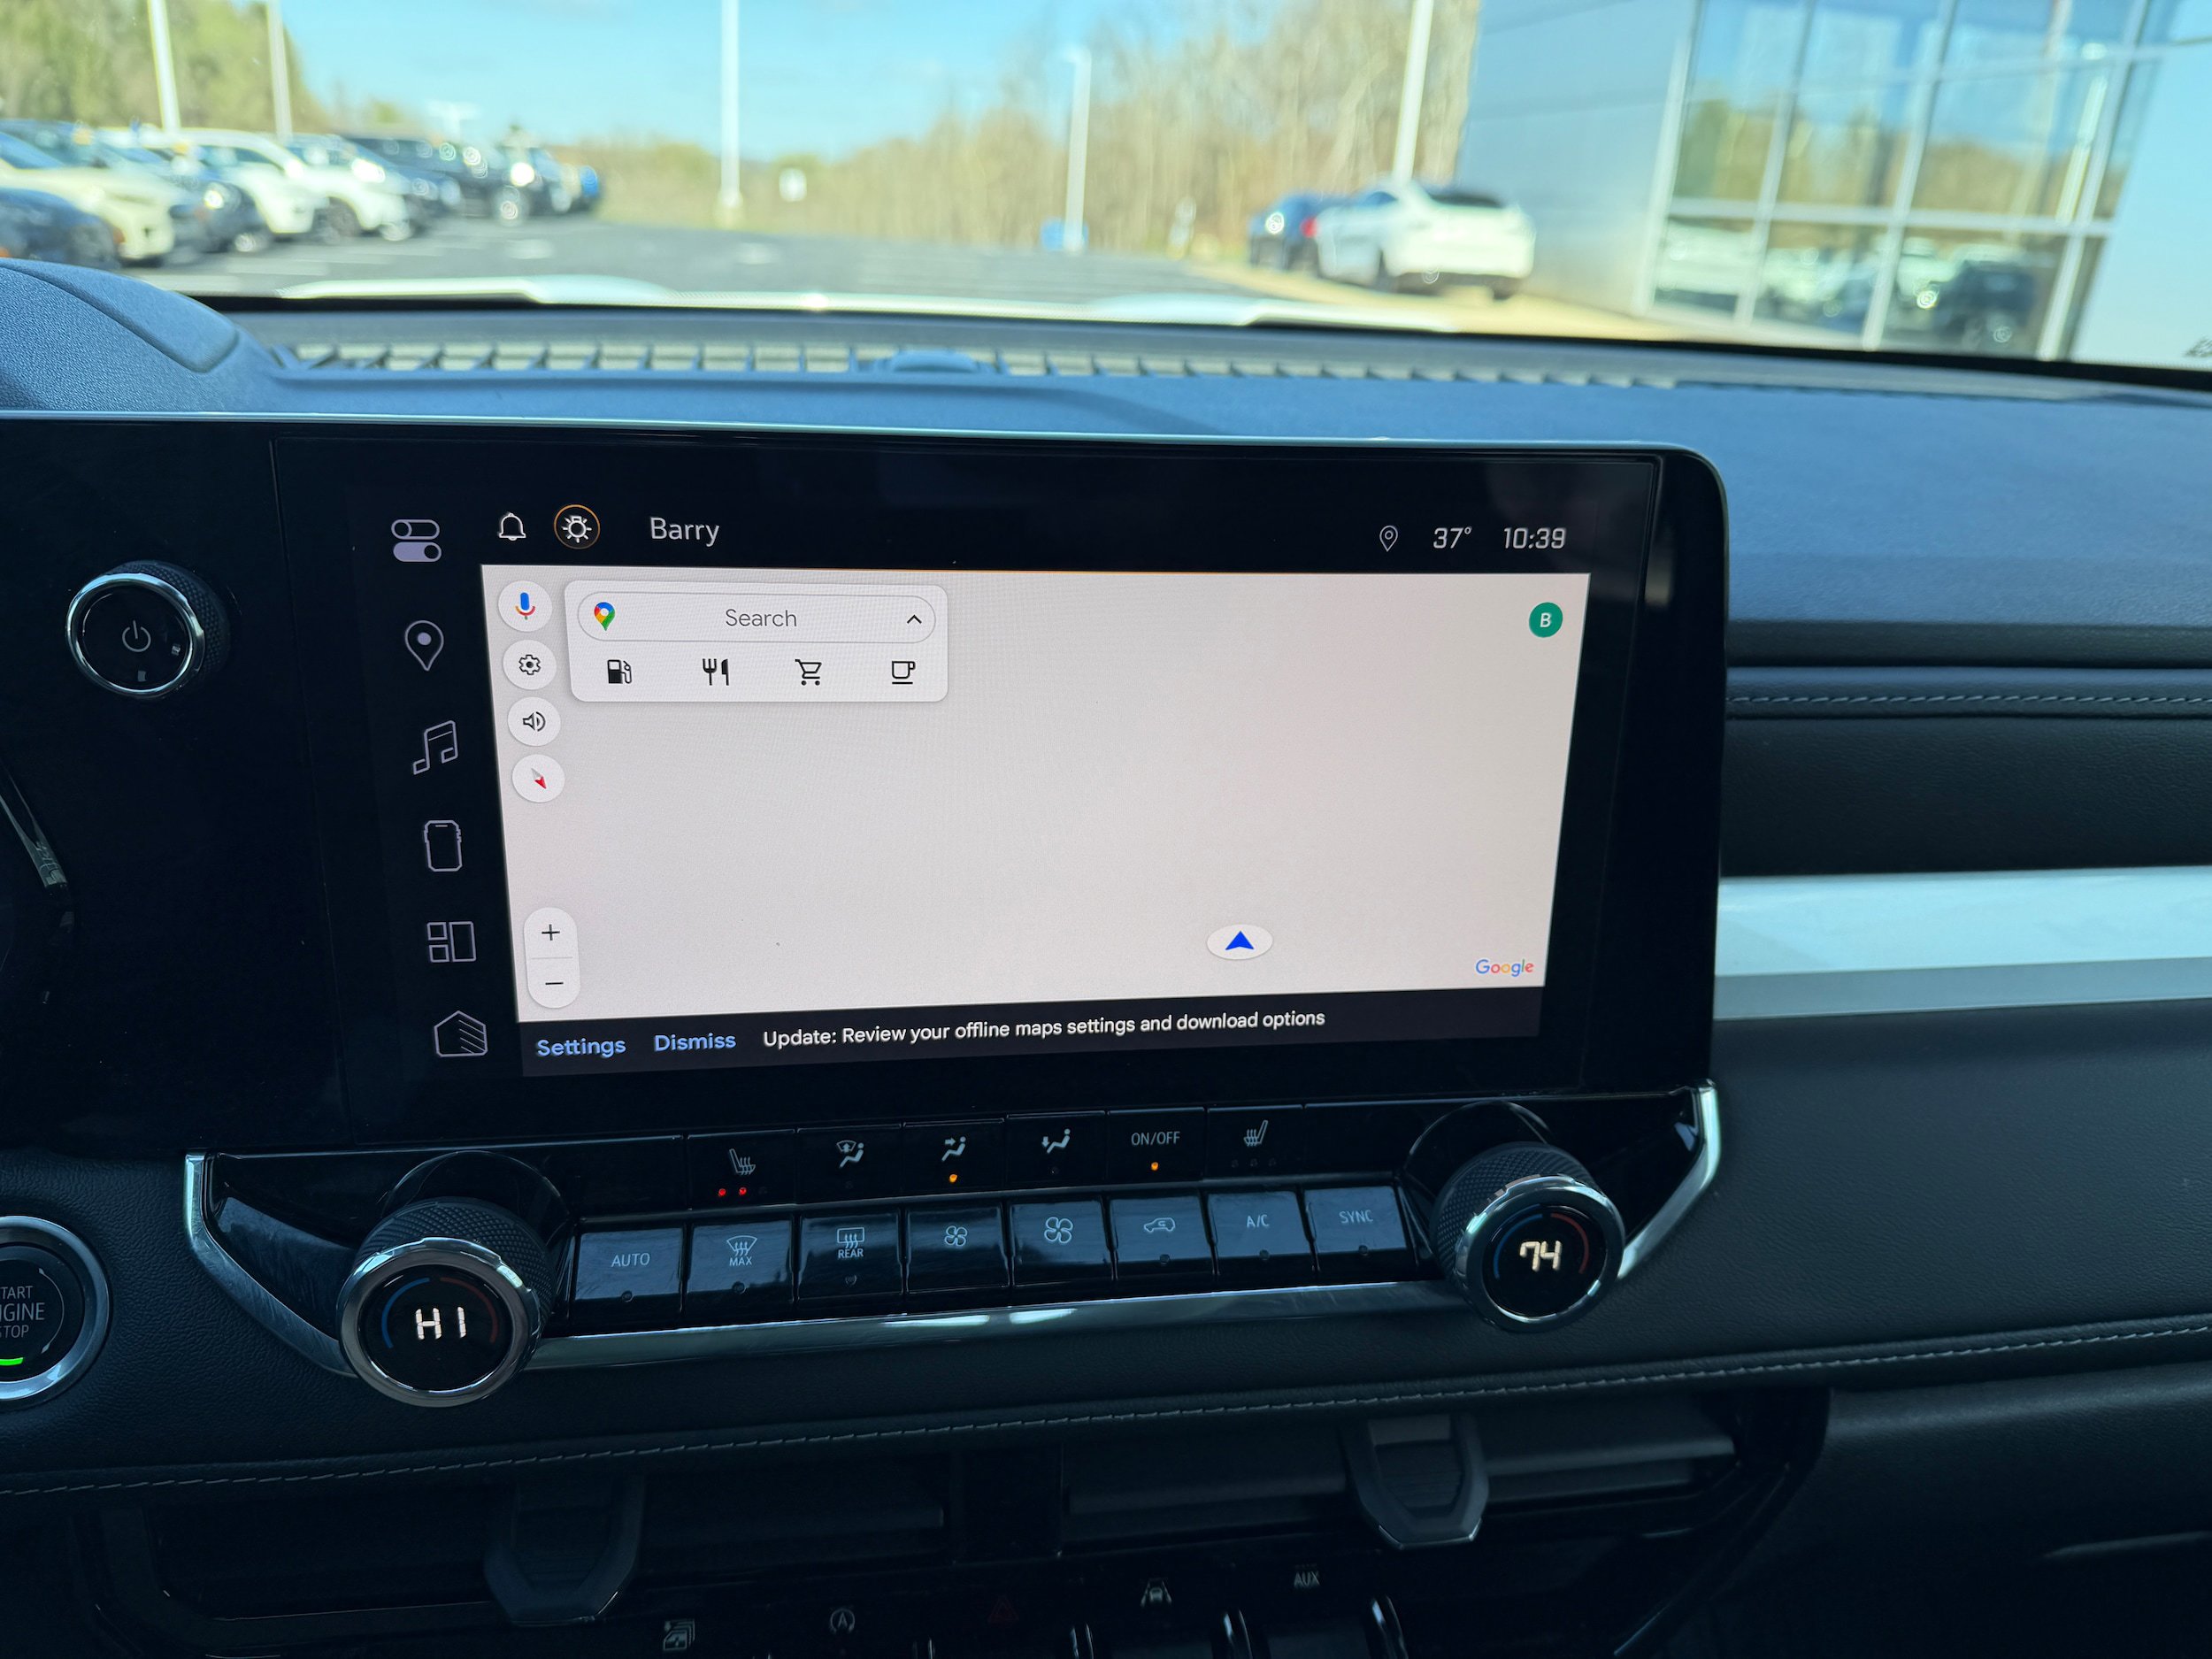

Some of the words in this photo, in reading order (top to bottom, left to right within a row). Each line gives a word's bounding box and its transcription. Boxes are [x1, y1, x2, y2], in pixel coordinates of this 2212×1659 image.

[649, 516, 720, 548] Barry
[1432, 526, 1473, 549] 37°
[1503, 526, 1567, 549] 10:39
[725, 608, 798, 627] Search
[1540, 611, 1552, 628] B
[1475, 956, 1535, 978] Google
[763, 1027, 838, 1048] Update:
[842, 1025, 907, 1044] Review
[910, 1024, 950, 1044] your
[954, 1020, 1010, 1040] offline
[1015, 1019, 1063, 1040] maps
[1066, 1016, 1136, 1037] settings
[1140, 1013, 1173, 1033] and
[1176, 1010, 1259, 1031] download
[1262, 1009, 1326, 1030] options
[536, 1038, 627, 1059] Settings
[654, 1032, 737, 1053] Dismiss
[1131, 1131, 1180, 1146] ON/OFF
[1246, 1214, 1270, 1228] A/C
[1339, 1210, 1374, 1225] SYNC
[611, 1252, 651, 1268] AUTO
[729, 1256, 752, 1266] MAX
[837, 1248, 864, 1259] REAR
[1519, 1240, 1563, 1271] 74
[0, 1285, 34, 1300] TART
[0, 1302, 45, 1323] GINE
[1294, 1571, 1320, 1588] AUX
